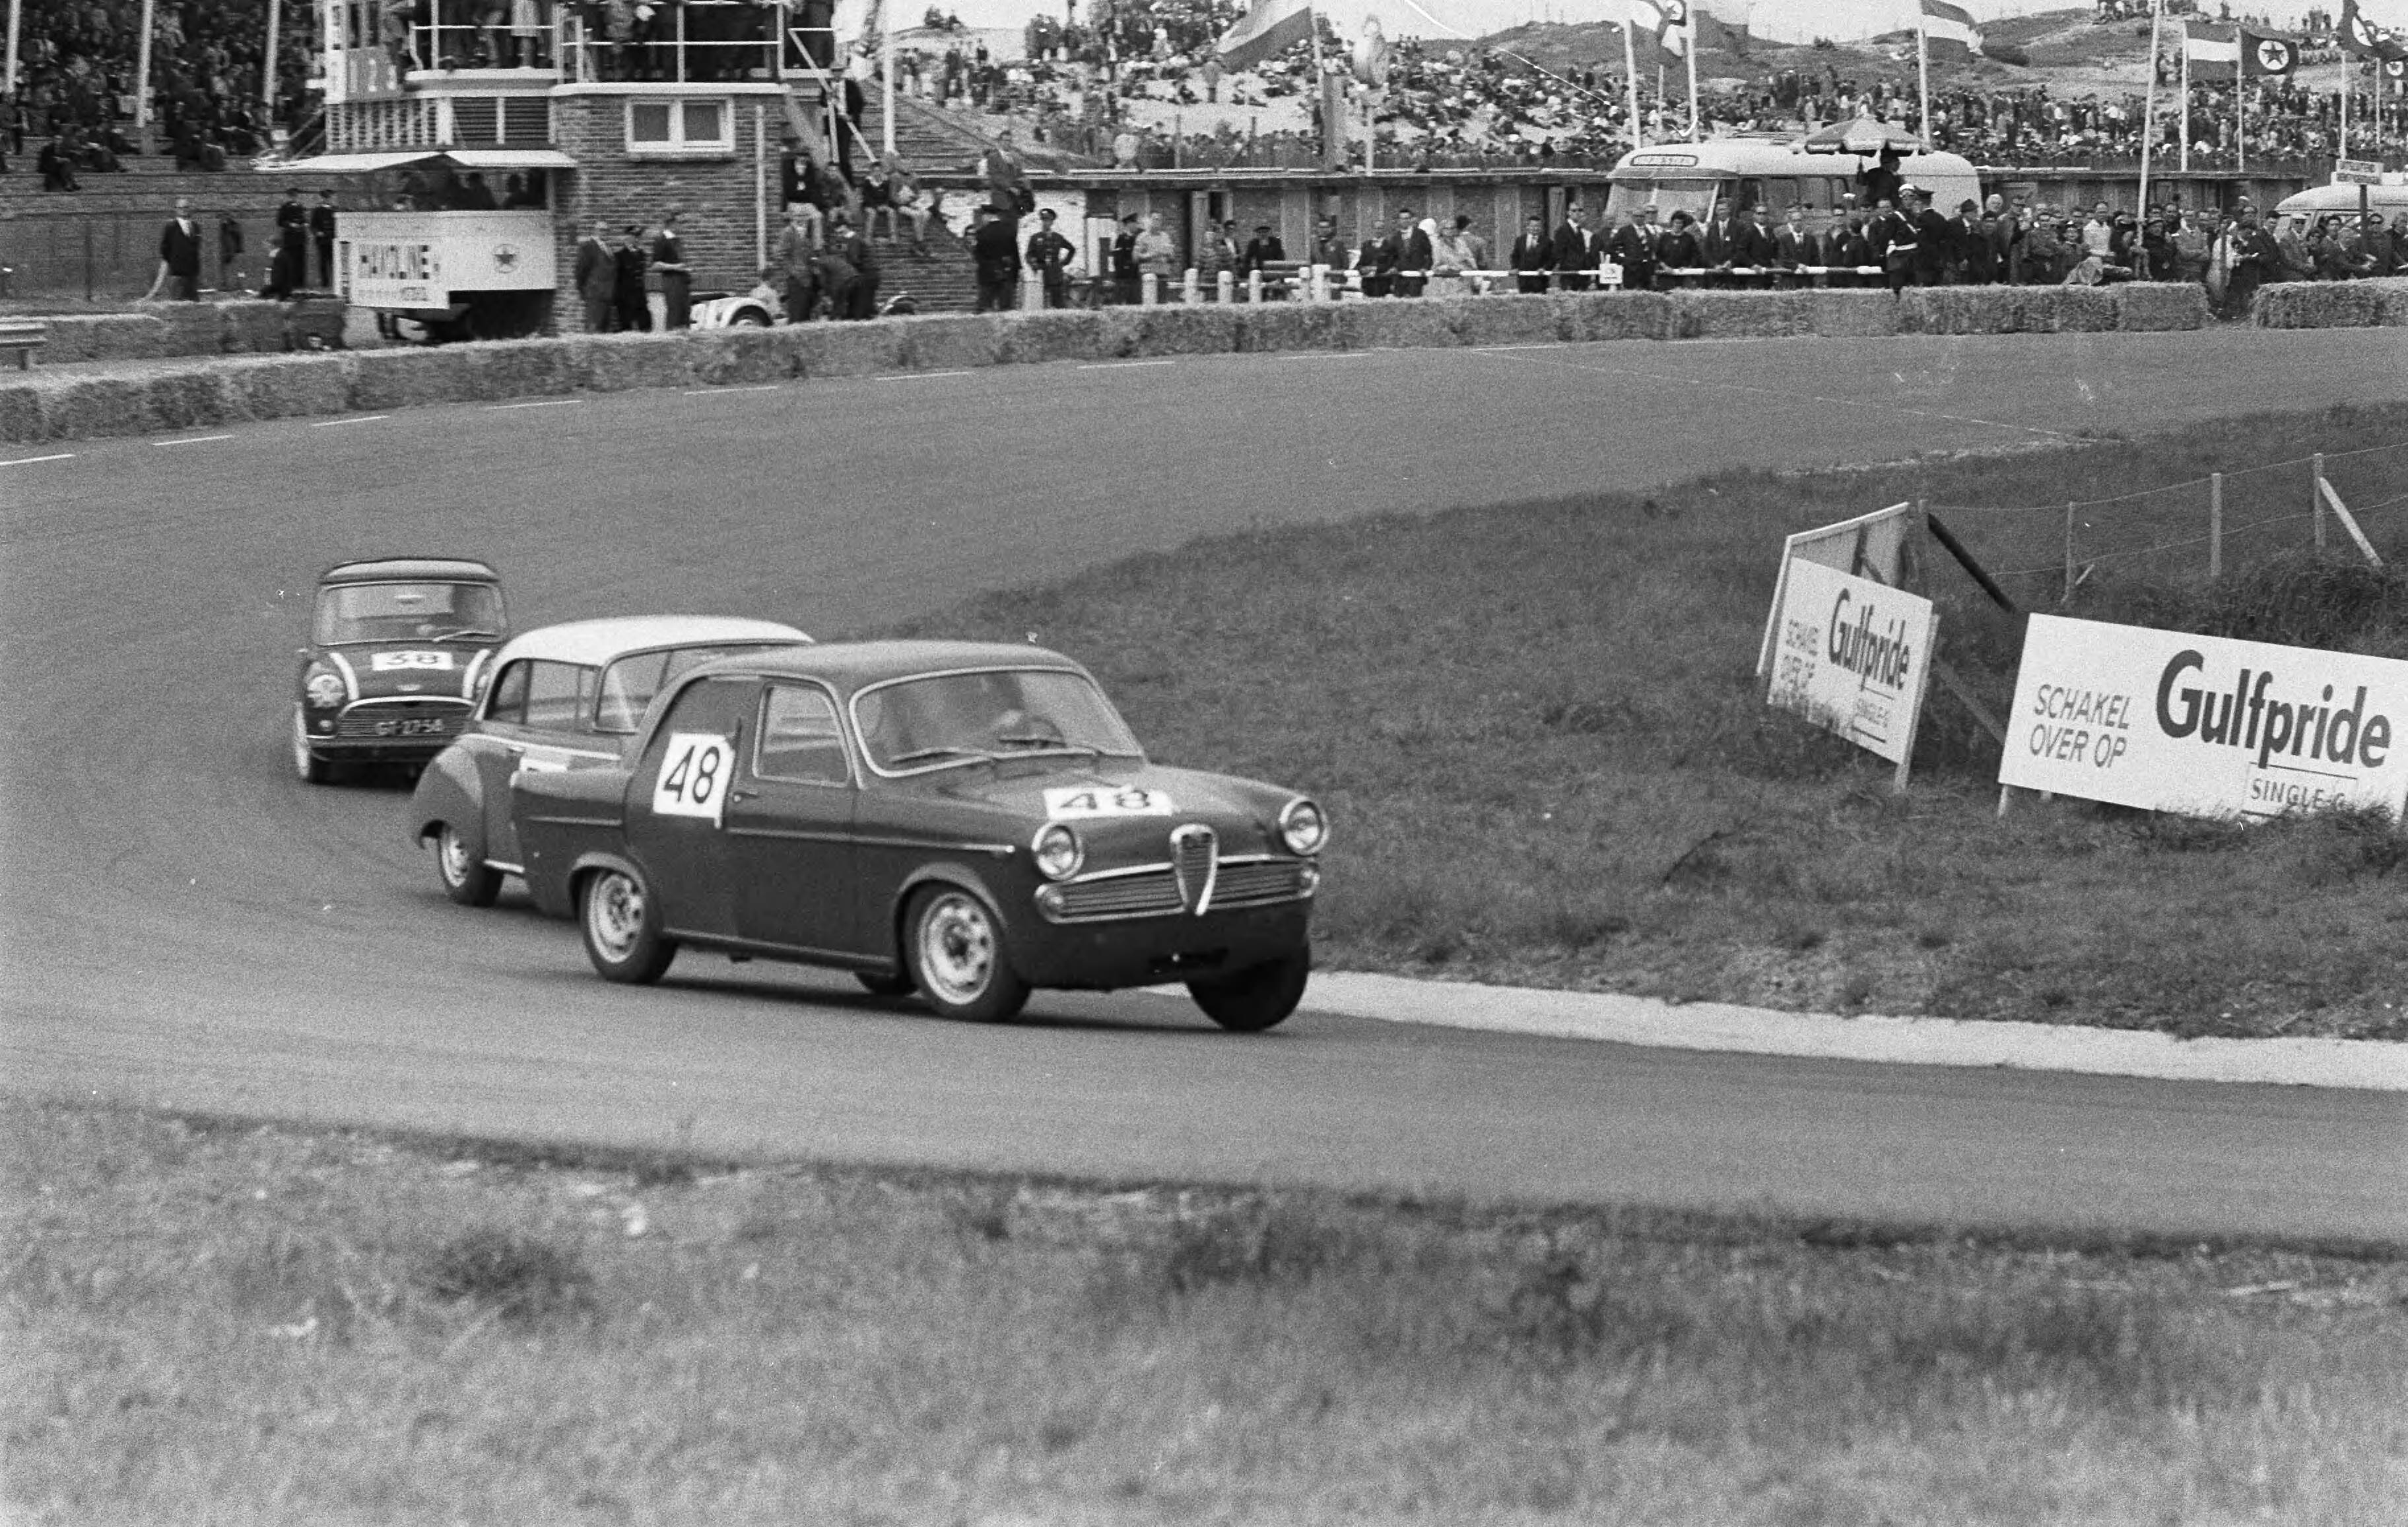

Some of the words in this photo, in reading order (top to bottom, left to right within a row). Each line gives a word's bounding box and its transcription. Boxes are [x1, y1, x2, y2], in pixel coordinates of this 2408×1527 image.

[1829, 587, 1910, 692] Gulfpride
[2034, 684, 2131, 730] SCHAKEL
[2156, 649, 2391, 769] Gulfpride
[2029, 723, 2089, 762] OVER
[2094, 734, 2127, 769] OP
[663, 745, 720, 804] 48
[1059, 789, 1151, 810] 48
